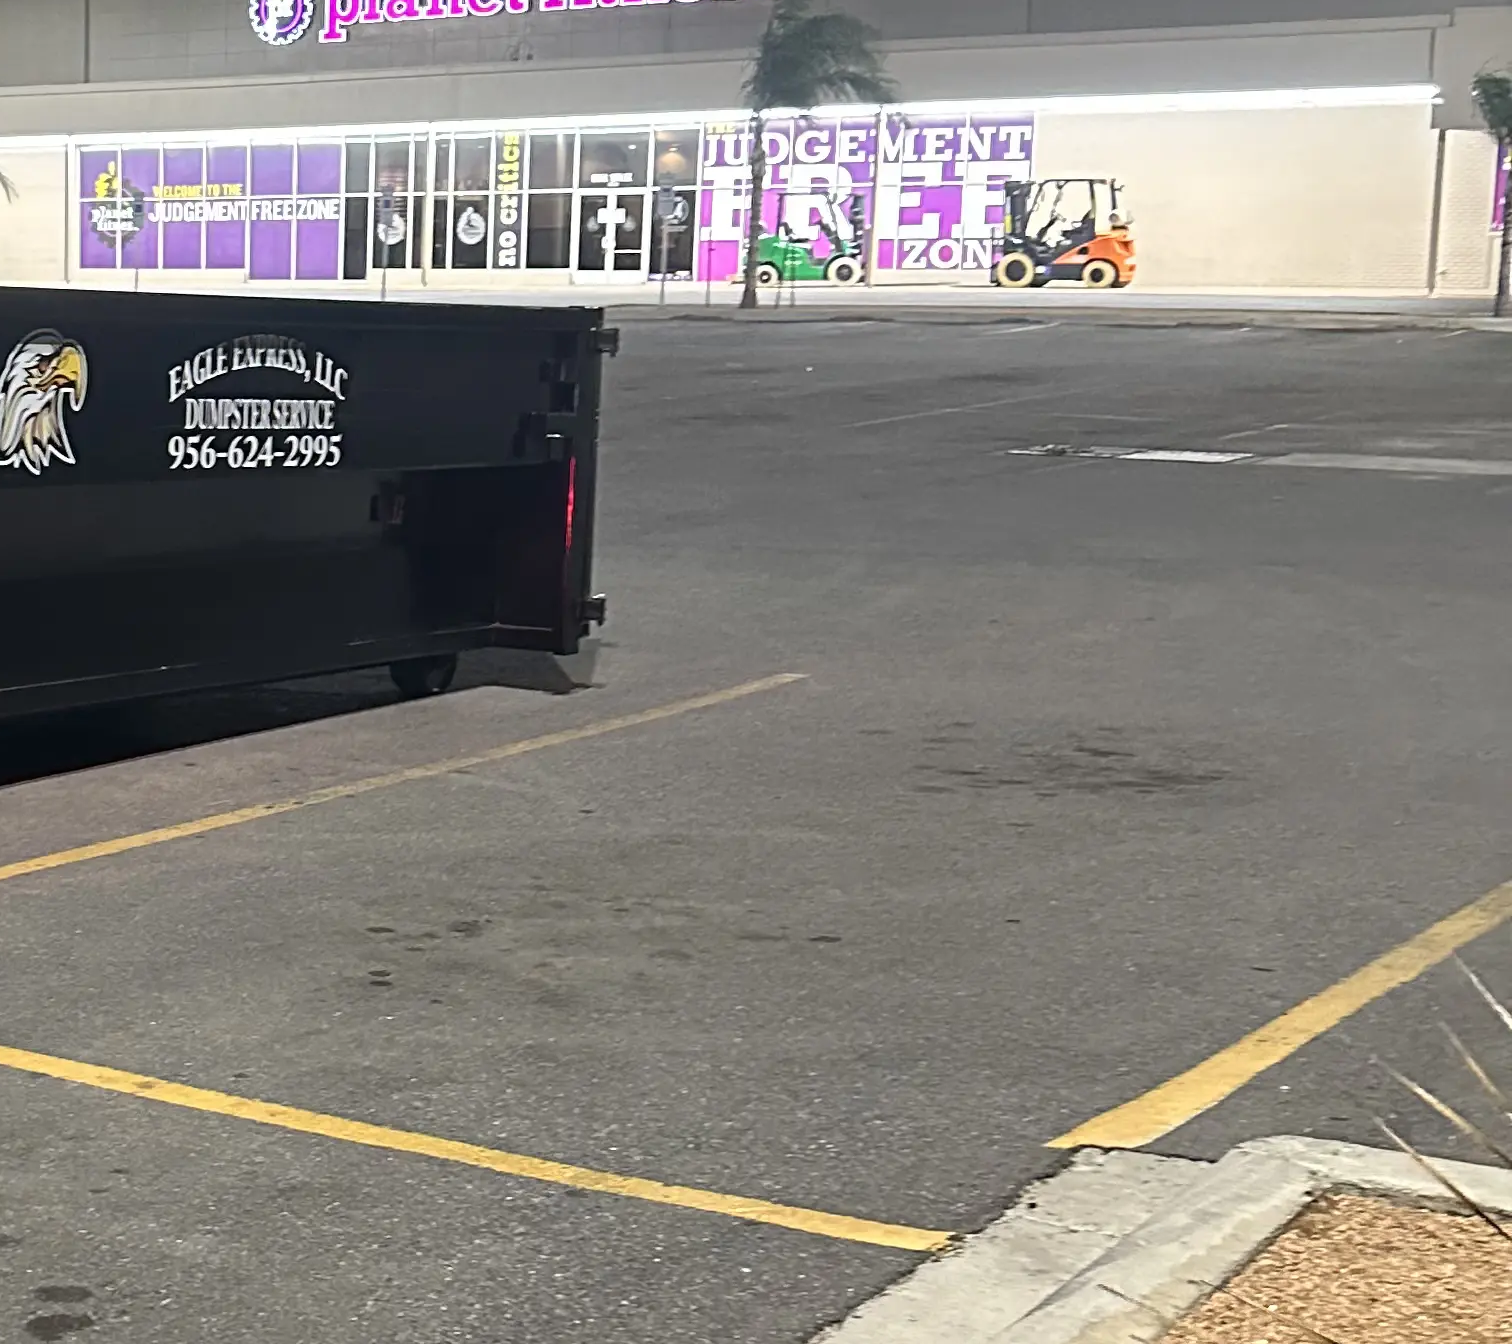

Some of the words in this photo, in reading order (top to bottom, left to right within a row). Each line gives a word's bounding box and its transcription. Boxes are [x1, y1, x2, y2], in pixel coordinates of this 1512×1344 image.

[703, 125, 1033, 166] JUDGEMENT
[152, 186, 202, 197] WELCOME
[207, 185, 221, 196] TO
[223, 184, 243, 195] THE
[148, 201, 248, 222] JUDGEMENT
[251, 201, 293, 221] FREE
[296, 199, 340, 219] ZONE
[901, 237, 1004, 269] ZON
[168, 342, 228, 402] EAGLE
[315, 351, 348, 400] LLC
[184, 398, 271, 430] DUMPSTER
[272, 399, 336, 430] SERVICE
[168, 434, 343, 469] 956-624-2995
